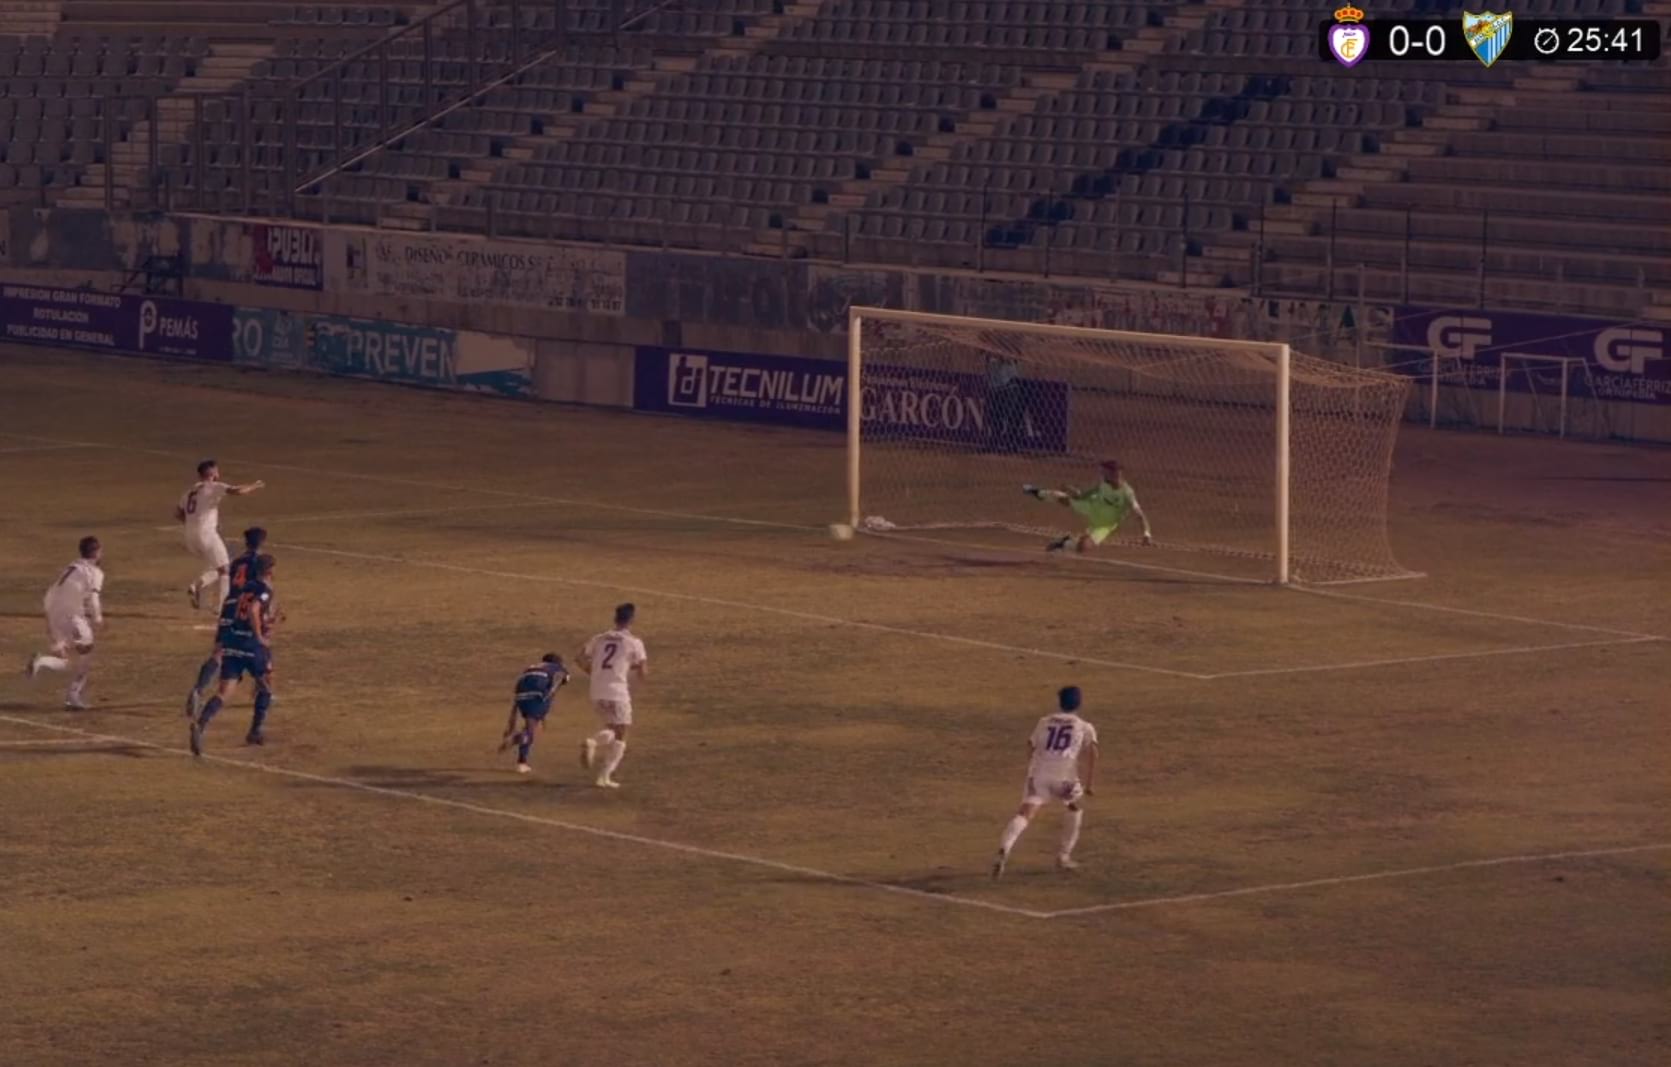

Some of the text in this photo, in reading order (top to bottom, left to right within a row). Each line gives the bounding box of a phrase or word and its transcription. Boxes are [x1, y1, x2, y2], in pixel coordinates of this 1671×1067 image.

[160, 315, 199, 340] PEMÁS
[1427, 316, 1493, 359] GF
[1593, 328, 1664, 374] GF
[709, 366, 844, 405] TECNILUM
[602, 643, 617, 669] 2
[1045, 725, 1073, 751] 16
